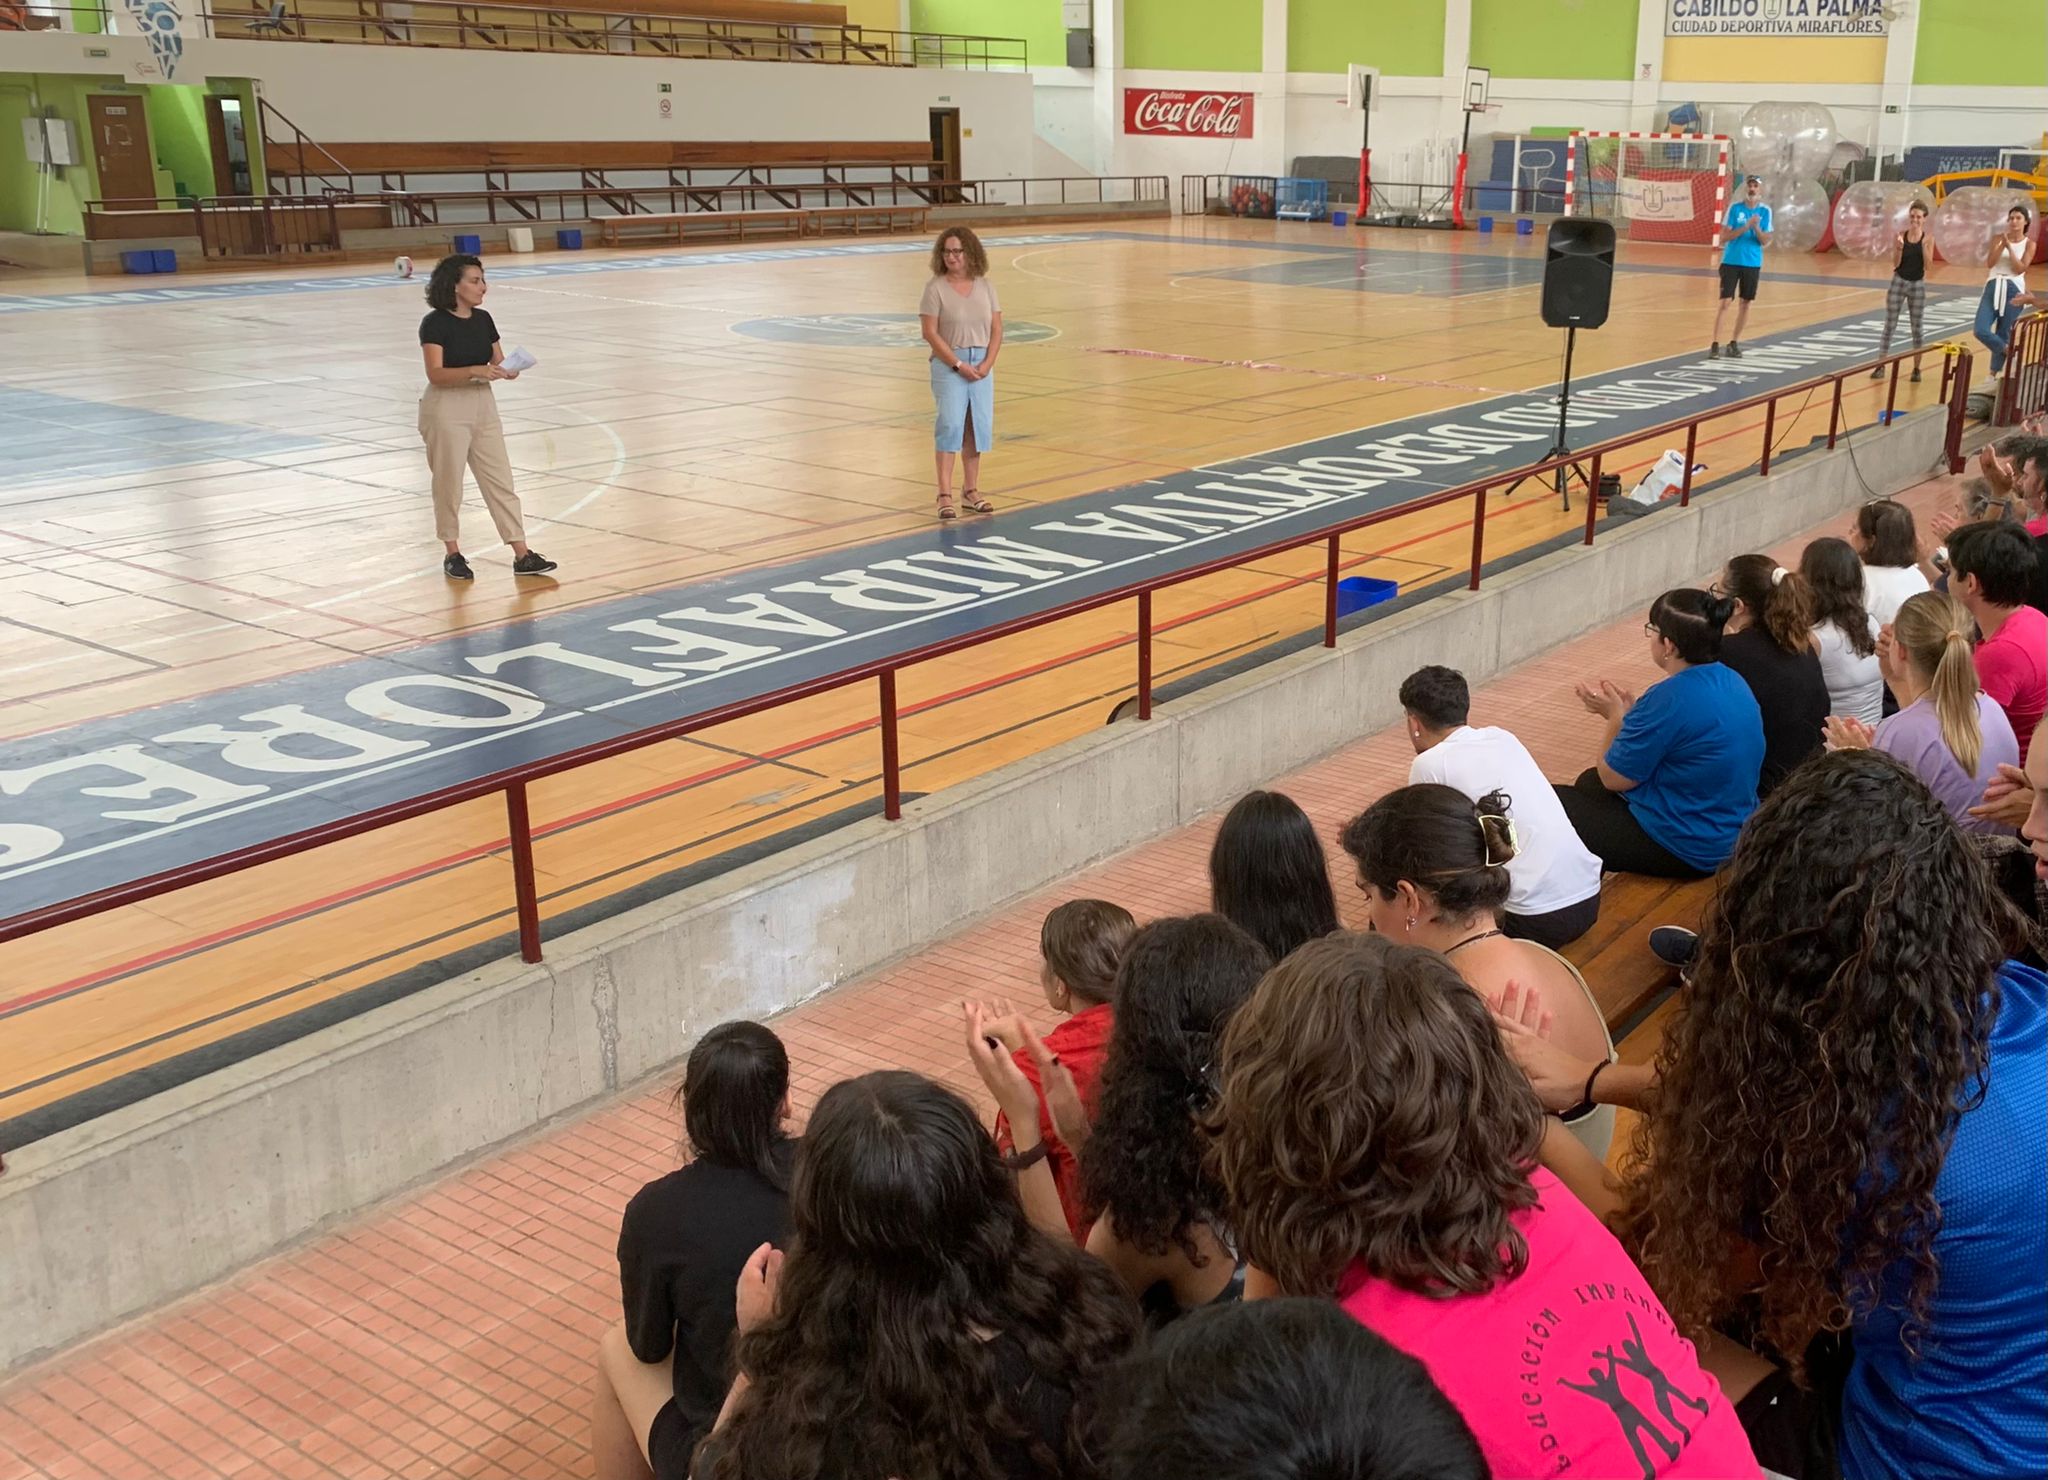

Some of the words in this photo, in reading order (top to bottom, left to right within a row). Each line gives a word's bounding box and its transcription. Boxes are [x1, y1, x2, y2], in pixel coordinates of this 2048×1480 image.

[1672, 20, 1717, 33] CIUDAD
[1721, 20, 1793, 33] DEPORTIVA
[1796, 20, 1883, 33] MIRAFLORES
[1673, 0, 1758, 17] CABILDO
[1786, 0, 1809, 17] LA
[1817, 0, 1882, 17] PALMA
[1135, 92, 1243, 133] Coca-Cola
[1481, 379, 1718, 428] CIUDAD
[1030, 424, 1549, 542] DEPORTIVA
[1519, 1306, 1572, 1474] EDUCACIÓN
